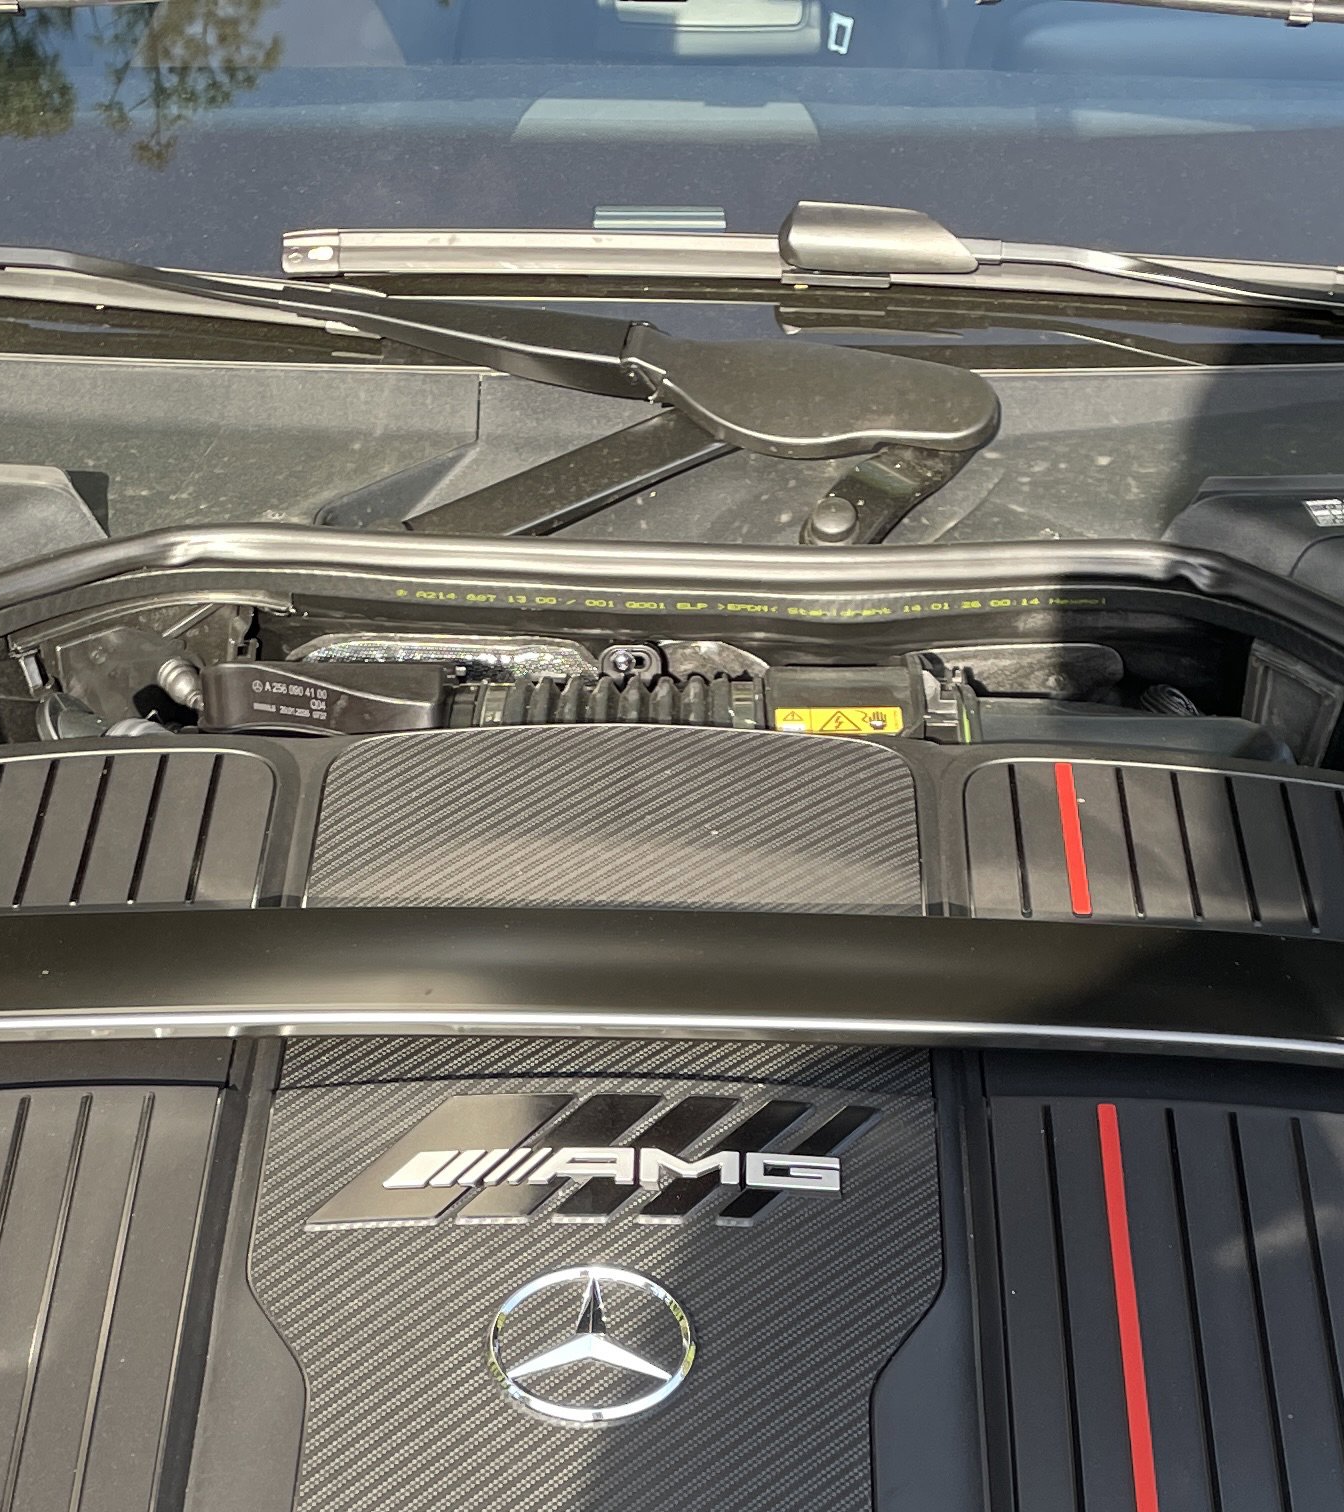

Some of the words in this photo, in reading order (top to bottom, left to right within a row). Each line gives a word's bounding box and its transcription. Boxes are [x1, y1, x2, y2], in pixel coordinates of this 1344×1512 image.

[264, 681, 272, 692] A
[304, 687, 315, 698] 41
[529, 1146, 843, 1194] AMG
